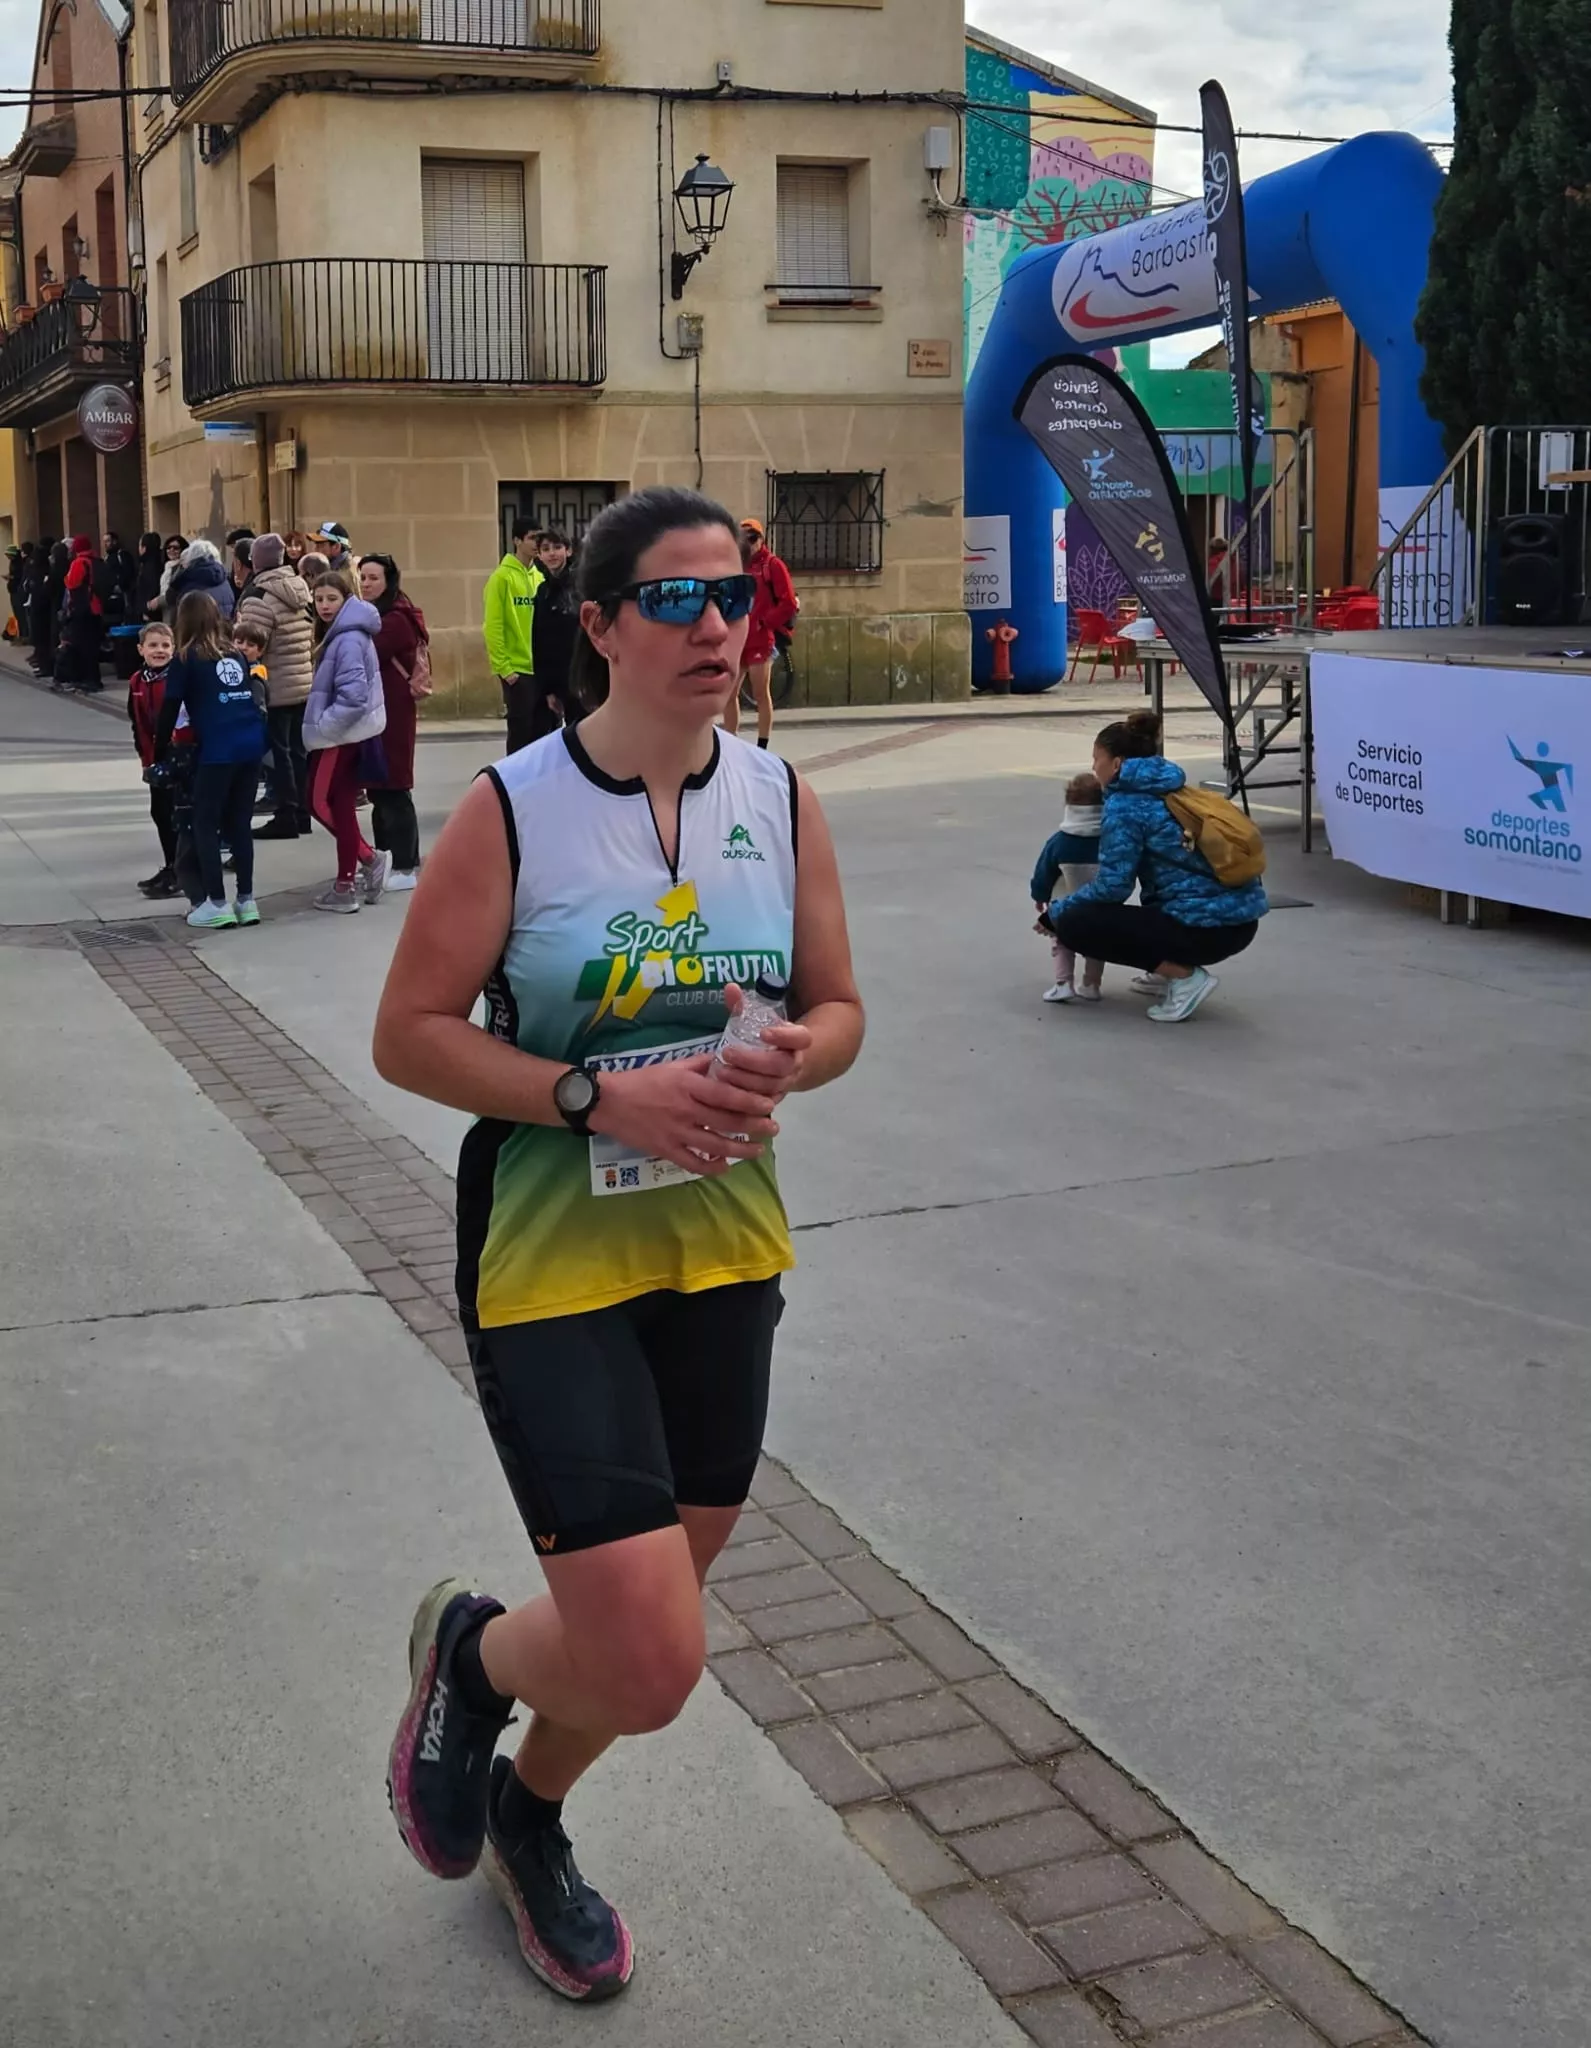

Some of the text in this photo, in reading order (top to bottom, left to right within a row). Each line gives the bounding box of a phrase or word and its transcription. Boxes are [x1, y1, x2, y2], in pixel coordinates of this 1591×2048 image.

[85, 411, 134, 425] AMBAR
[964, 588, 1000, 604] astro
[1358, 739, 1422, 766] Servicio
[1348, 761, 1422, 791] Comarcal
[1336, 781, 1424, 815] de Deportes
[1491, 808, 1571, 838] deportes
[1464, 827, 1582, 863] somontano
[604, 911, 708, 968] Sport
[666, 990, 707, 1007] CLUB
[420, 1677, 449, 1762] HOKA
